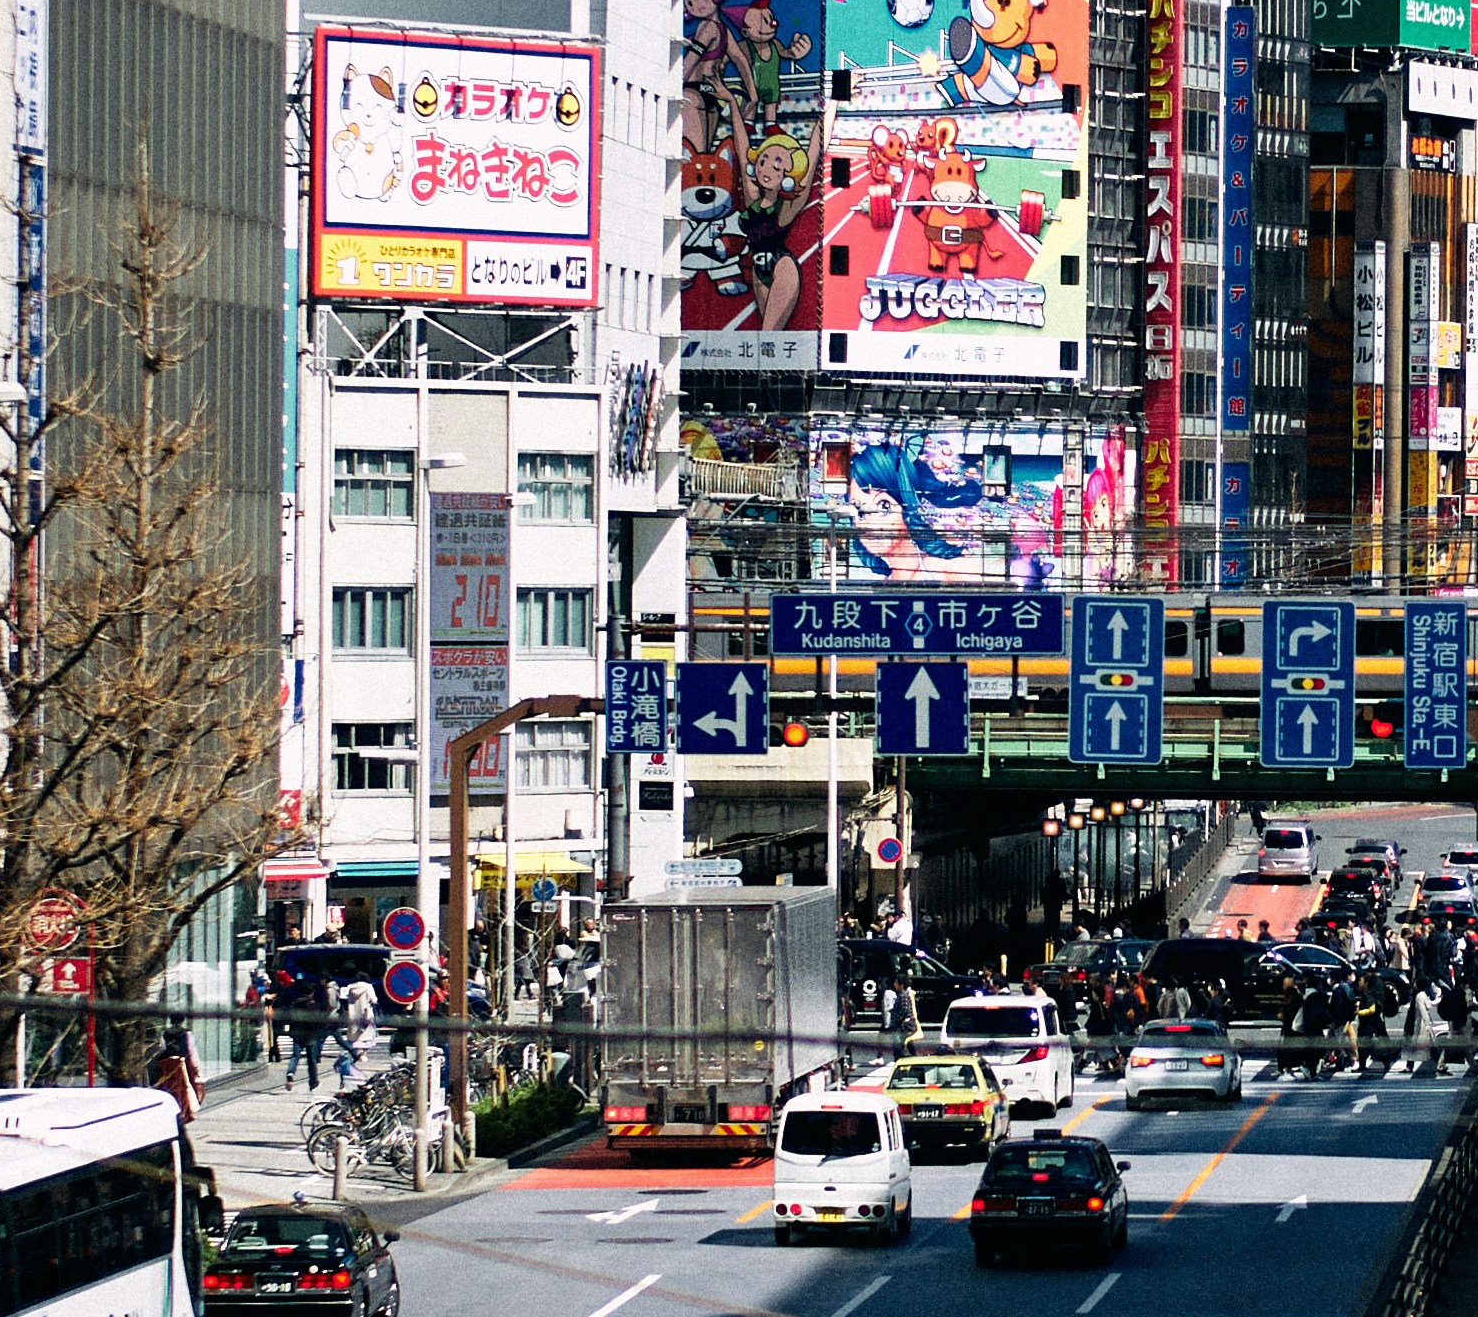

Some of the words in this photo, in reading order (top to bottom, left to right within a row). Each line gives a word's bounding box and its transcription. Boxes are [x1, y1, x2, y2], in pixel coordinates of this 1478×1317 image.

[443, 80, 551, 120] カラオケ
[411, 131, 580, 204] まねきねこ
[1146, 131, 1173, 312] エスパス
[371, 263, 457, 290] ワンカラ
[469, 253, 547, 286] となりのビル
[566, 258, 587, 289] 4F
[859, 272, 1046, 330] JUGGLER
[1355, 264, 1374, 365] 小松ビル
[737, 340, 798, 360] 北電子
[953, 345, 1007, 364] 北電子
[449, 574, 502, 628] 210
[793, 600, 900, 630] 九段下
[913, 617, 924, 633] 4
[432, 649, 508, 665] スポクラが安い
[801, 632, 891, 649] Kudanshita
[956, 632, 1023, 651] Ichigaya
[1409, 615, 1431, 690] Shinjuku
[610, 666, 628, 705] Otaki
[1432, 611, 1459, 759] 新宿駅東口
[630, 666, 661, 748] 小滝橋
[609, 709, 628, 746] Brdg.
